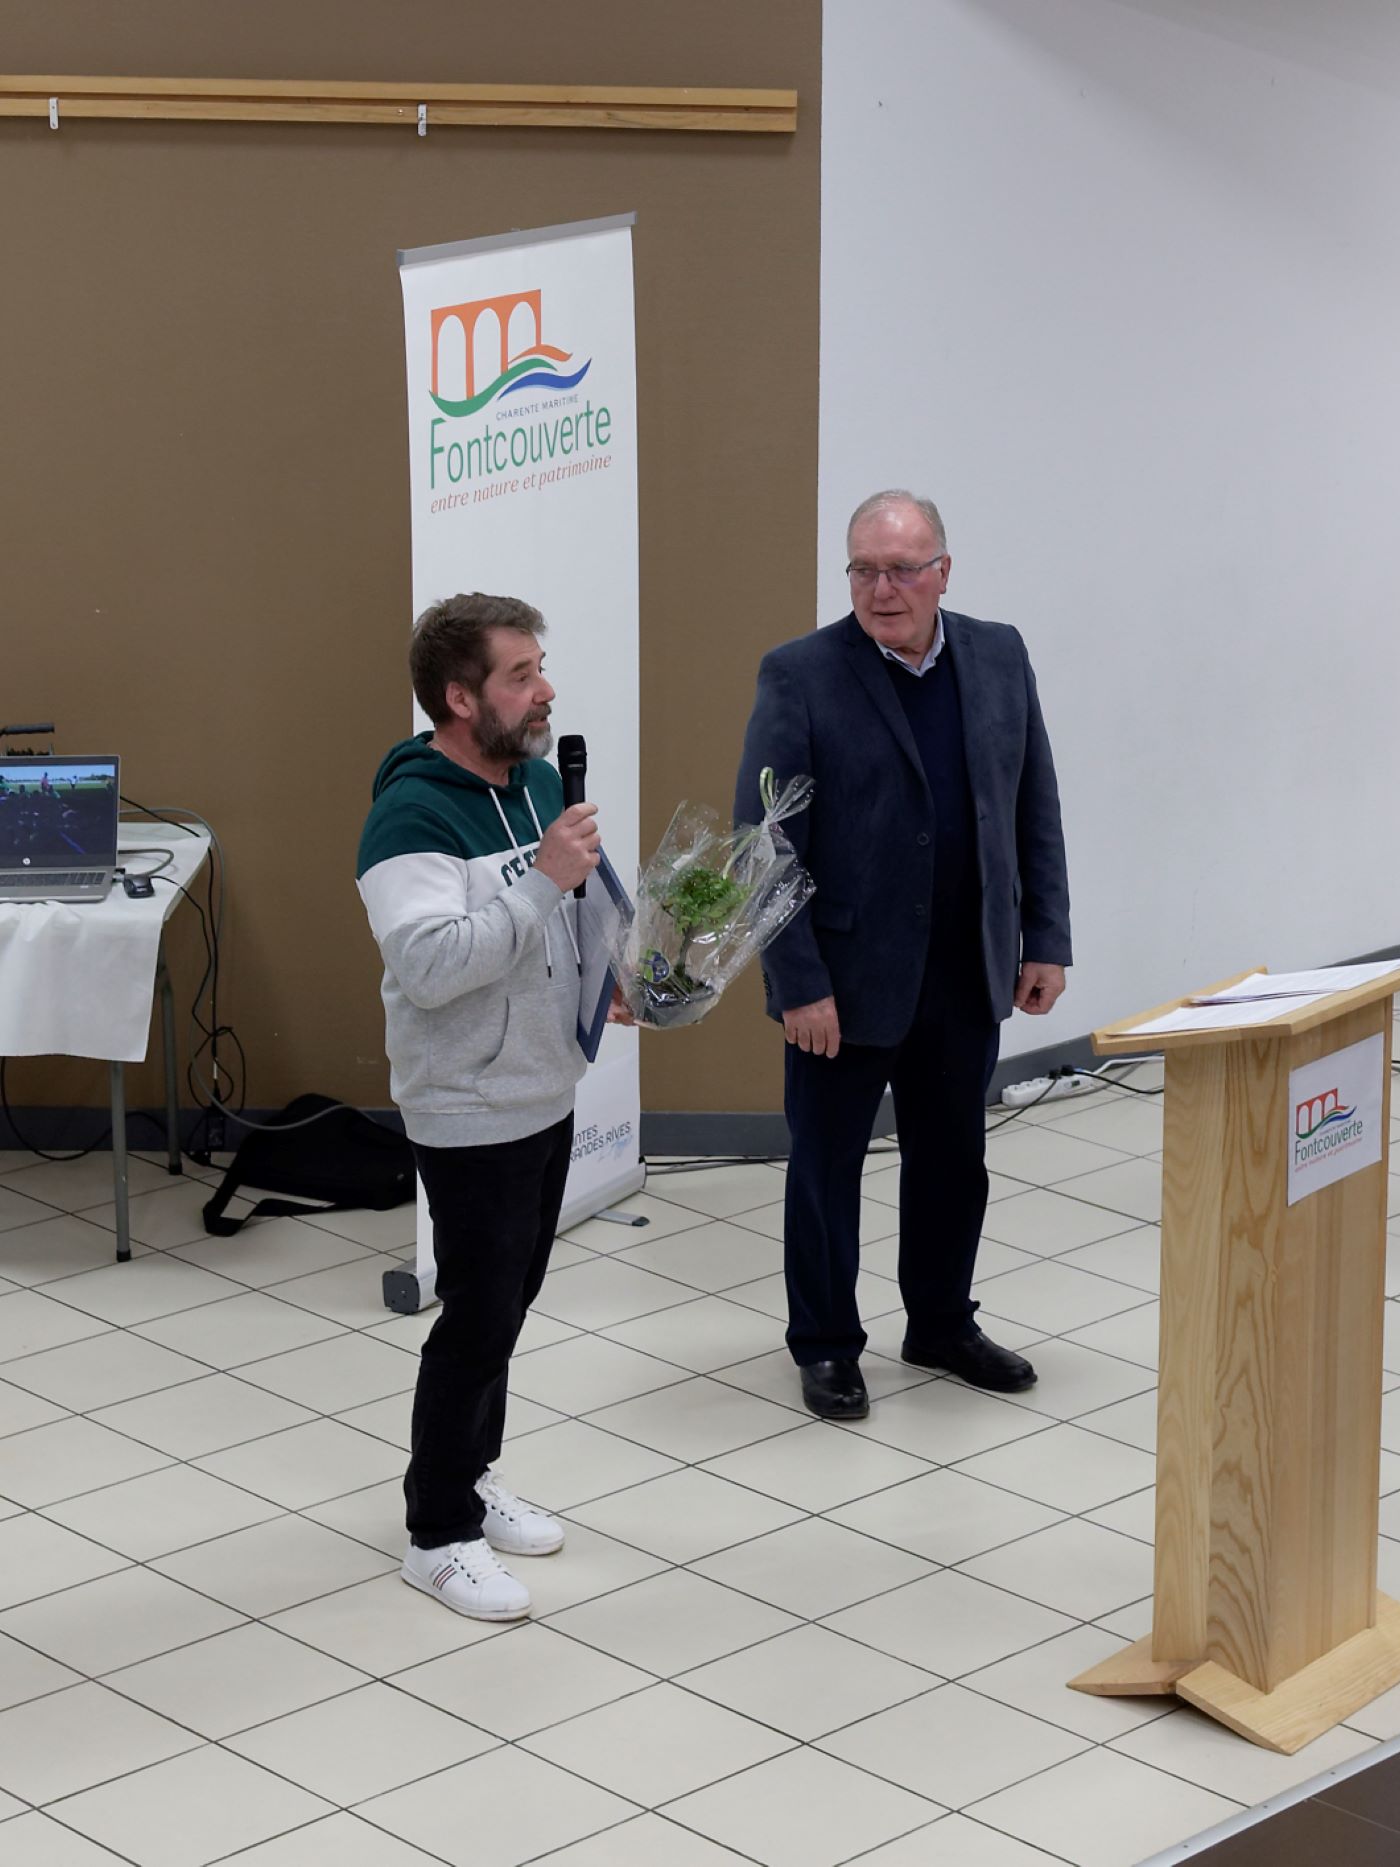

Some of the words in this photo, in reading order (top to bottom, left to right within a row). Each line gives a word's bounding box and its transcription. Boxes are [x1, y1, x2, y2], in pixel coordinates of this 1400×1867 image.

[496, 403, 539, 421] CHARENTE
[430, 399, 612, 490] Fontcouverte
[430, 490, 469, 514] entre
[473, 478, 519, 503] nature
[523, 474, 535, 490] et
[537, 454, 612, 491] patrimoine
[606, 1121, 631, 1144] RIVES
[1295, 1119, 1363, 1166] Fontcouverte
